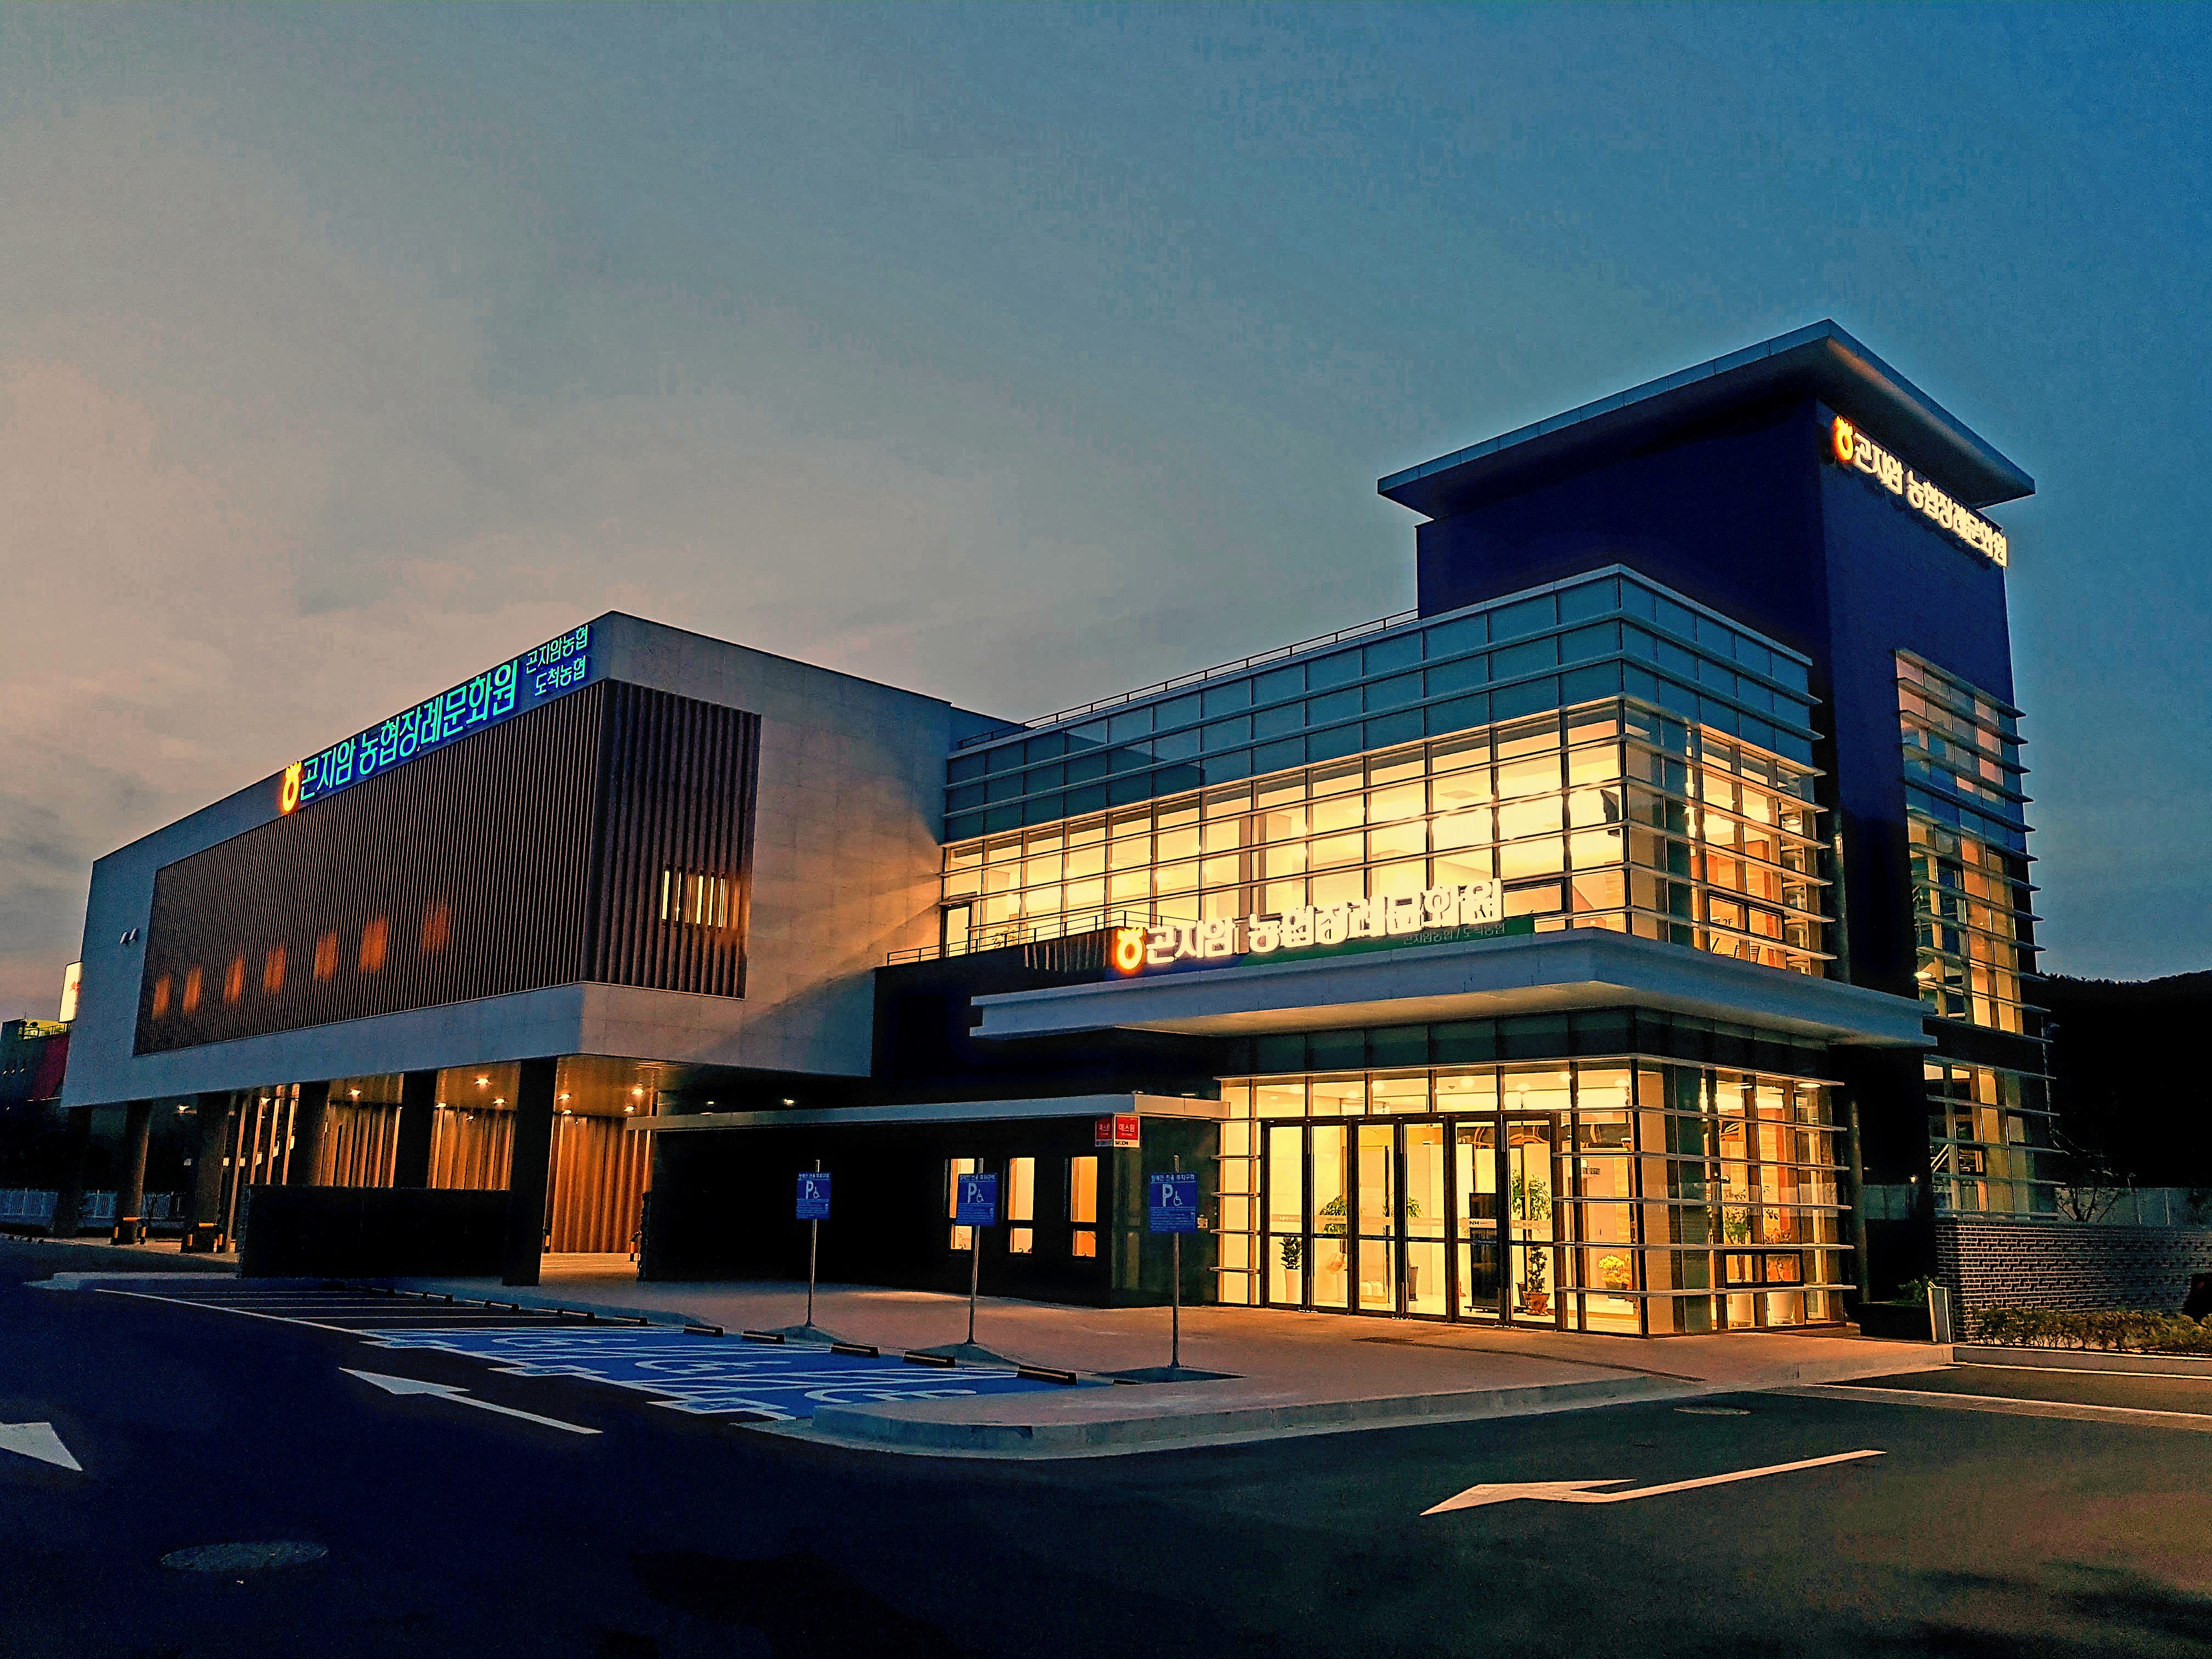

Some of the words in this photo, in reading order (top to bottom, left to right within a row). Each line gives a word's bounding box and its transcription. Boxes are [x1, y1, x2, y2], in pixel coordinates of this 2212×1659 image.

[1855, 432, 1904, 494] 곤지암
[1908, 470, 2007, 567] 농협장례문화원
[526, 624, 588, 674] 곤지암농협
[534, 655, 586, 696] 도척농협
[300, 737, 356, 801] 곤지암
[359, 659, 518, 775] 농협장례문화원
[1146, 916, 1237, 964] 곤지암
[1248, 878, 1503, 953] 농협장례문화원
[806, 1181, 814, 1199] P
[968, 1182, 977, 1204] P
[1163, 1183, 1173, 1207] P
